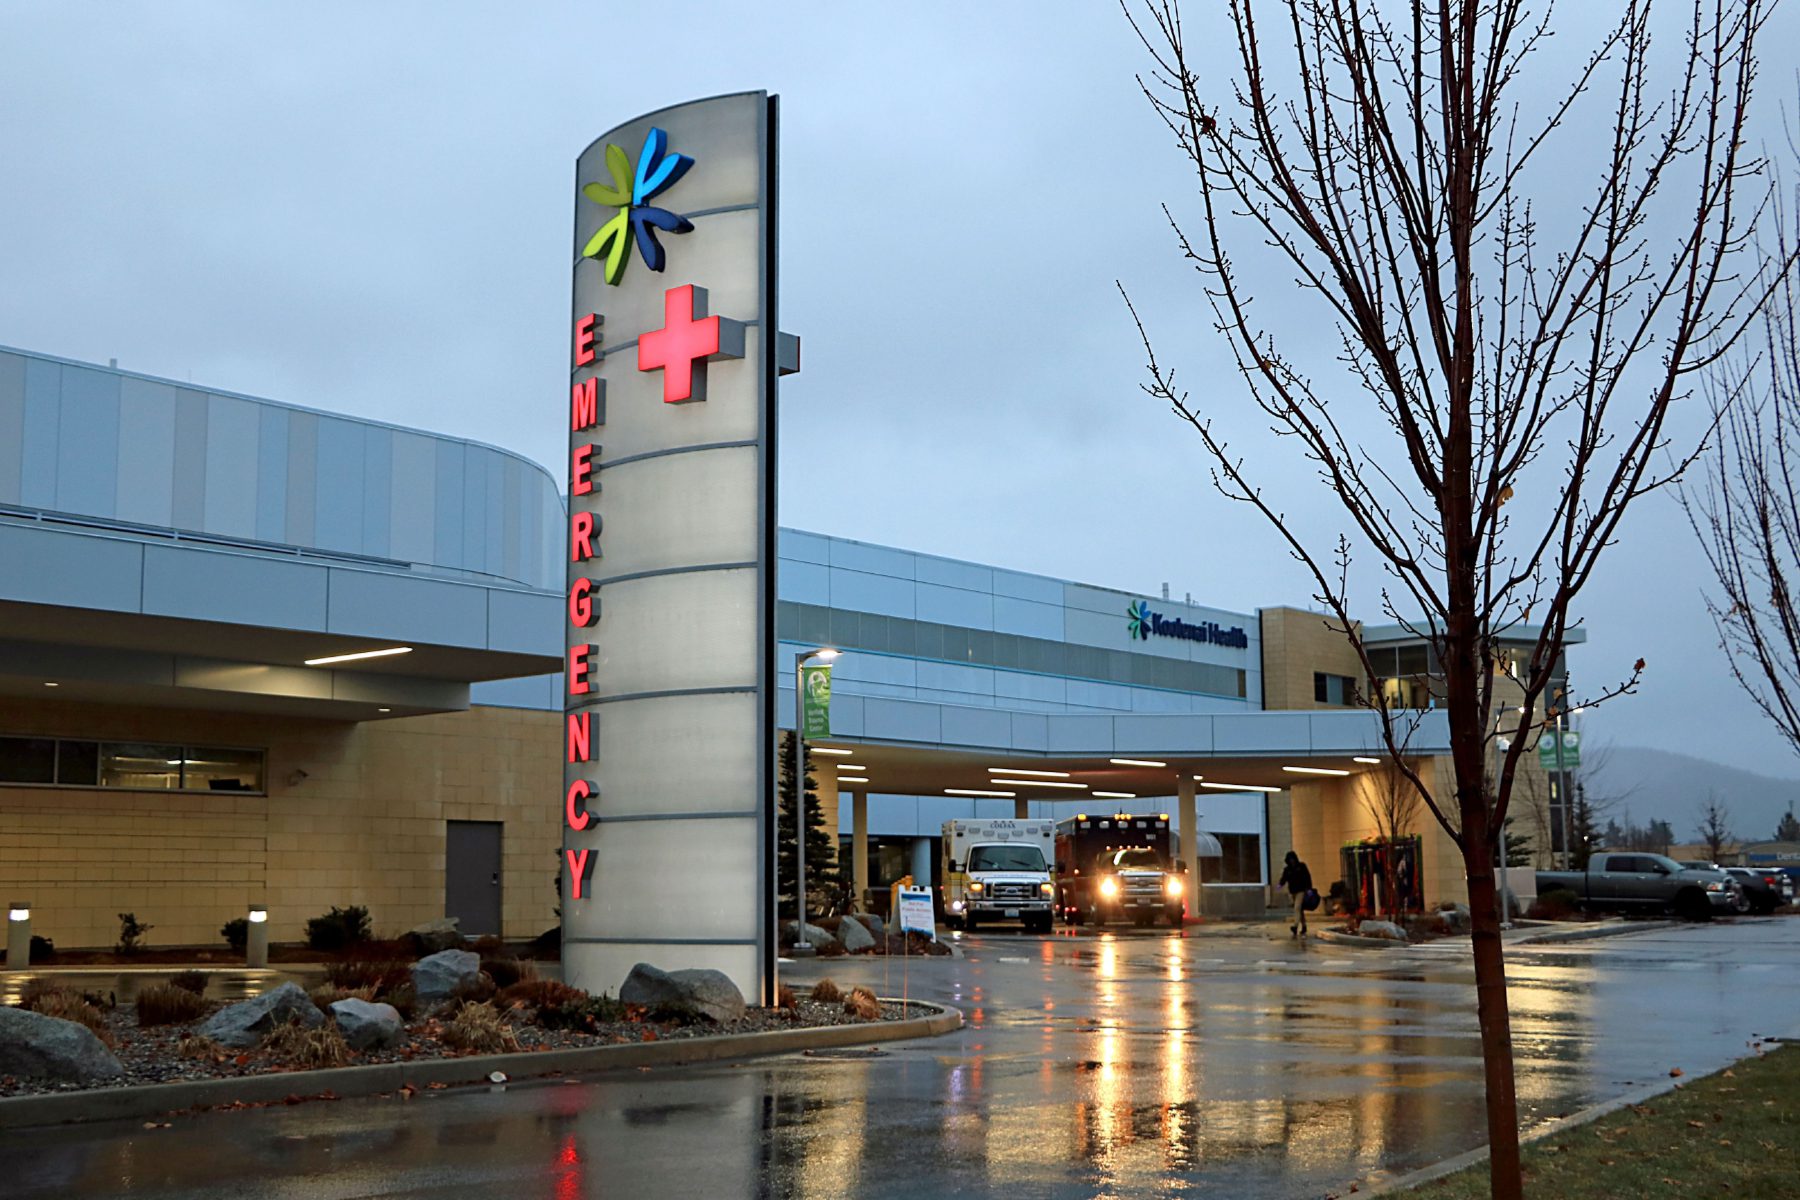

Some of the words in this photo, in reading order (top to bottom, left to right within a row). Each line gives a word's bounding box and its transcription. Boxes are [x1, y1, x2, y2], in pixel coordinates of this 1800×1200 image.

[566, 312, 600, 899] EMERGENCY
[1152, 612, 1207, 643] Kootenai
[1208, 622, 1248, 649] Health
